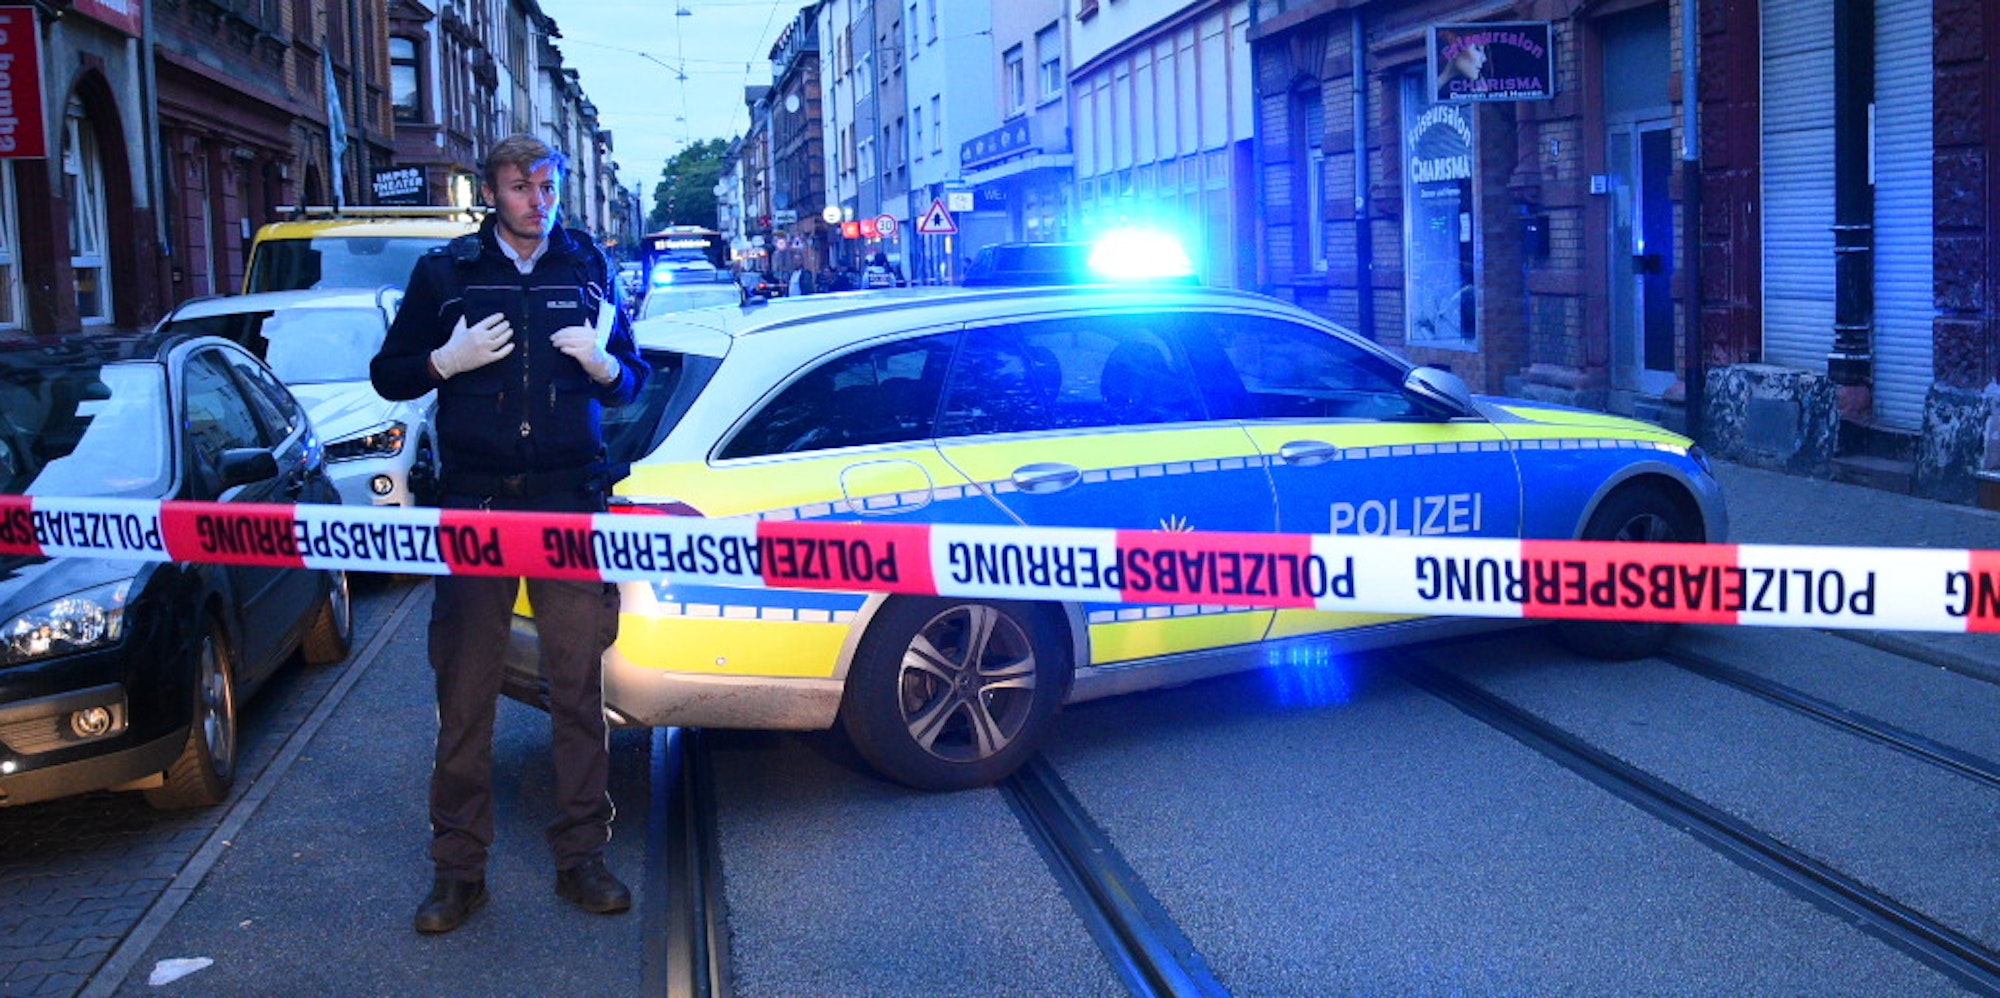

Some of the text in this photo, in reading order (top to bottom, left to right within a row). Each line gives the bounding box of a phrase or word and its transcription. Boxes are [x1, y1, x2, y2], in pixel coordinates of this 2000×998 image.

[1441, 32, 1544, 60] Friseursalon
[1449, 77, 1542, 92] CHARISMA
[1408, 104, 1471, 151] Friseursalon
[373, 177, 423, 192] THEATER
[376, 168, 419, 183] IMPRO
[1411, 154, 1471, 183] CHARISMA
[880, 220, 892, 231] 30
[1330, 493, 1481, 536] POLIZEI
[196, 514, 504, 567] POLIZEIABSPERRUNG
[542, 527, 899, 583] POLIZEIABSPERRUNG
[948, 542, 1356, 598] POLIZEIABSPERRUNG
[1415, 556, 1876, 616] POLIZEIABSPERRUNG
